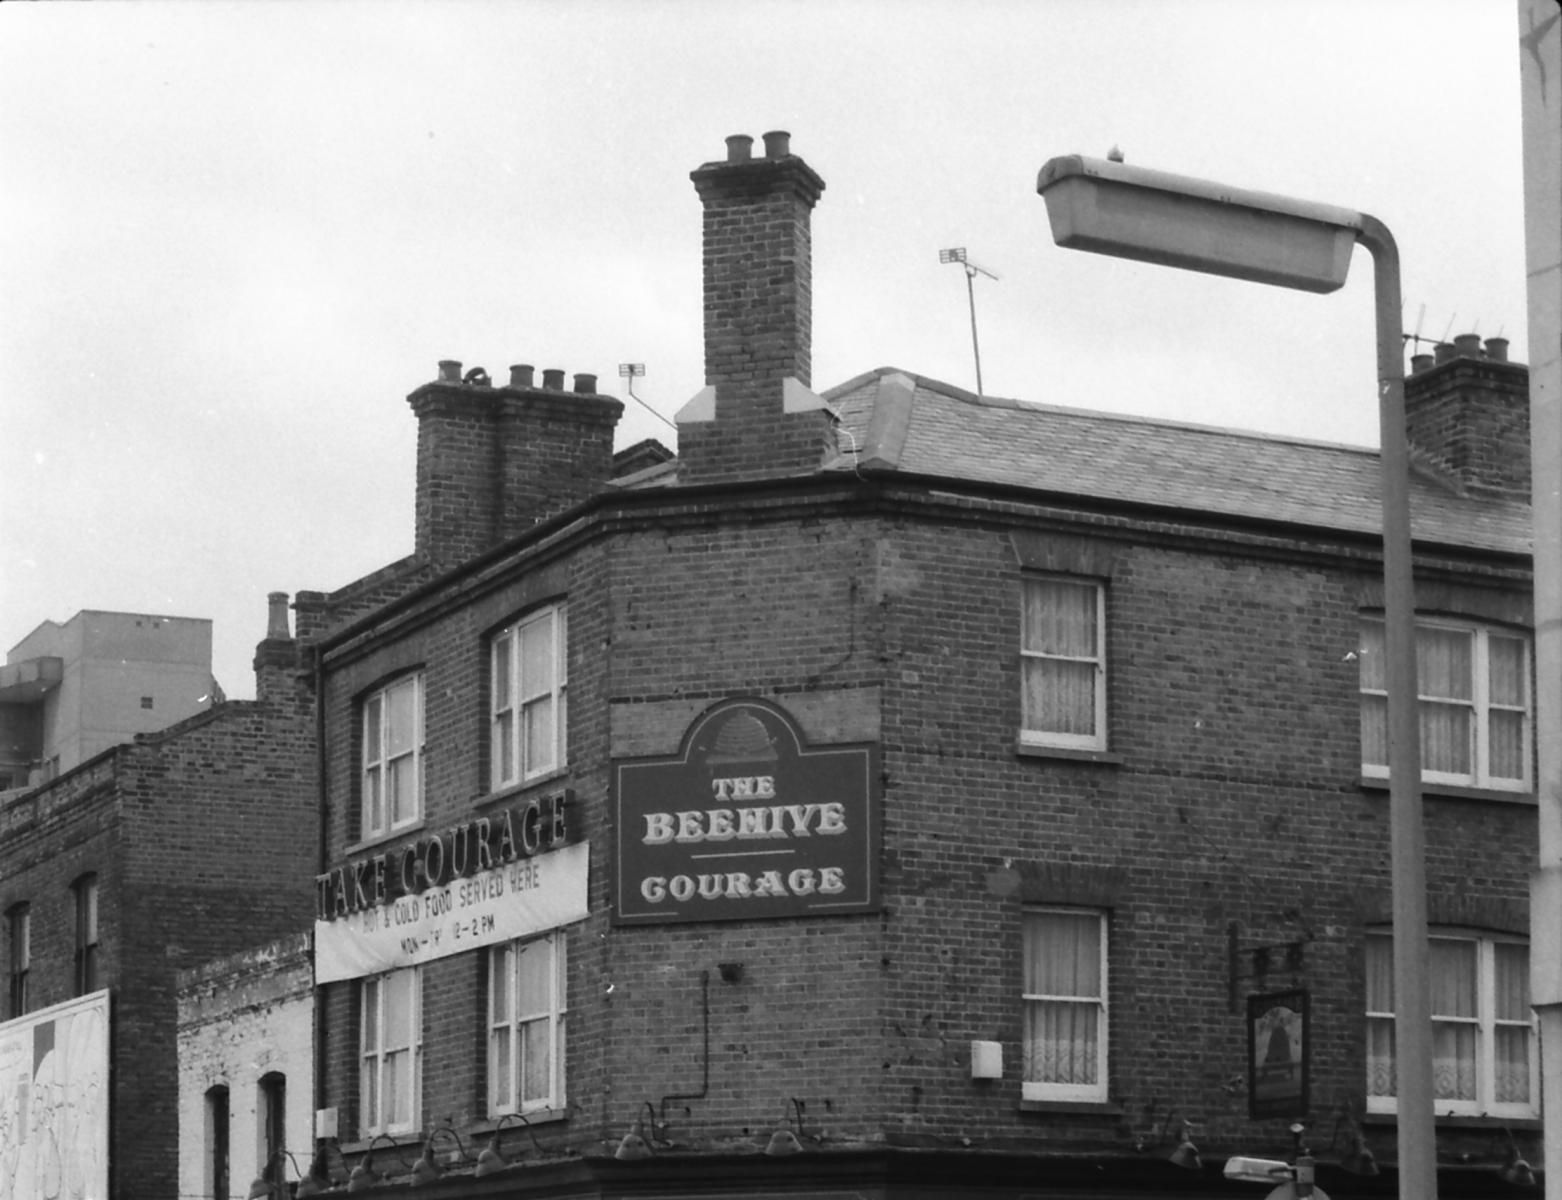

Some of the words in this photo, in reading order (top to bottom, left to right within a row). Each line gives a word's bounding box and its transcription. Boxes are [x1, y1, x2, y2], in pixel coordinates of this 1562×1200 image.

[712, 776, 776, 801] THE
[641, 802, 848, 845] BEEHIVE
[315, 855, 390, 921] TAKE
[401, 789, 572, 894] COURAGE
[394, 901, 420, 926] COLD
[425, 890, 453, 919] FOOD
[459, 873, 504, 908] SERVED
[509, 863, 540, 893] HERE
[640, 867, 847, 903] COURAGE
